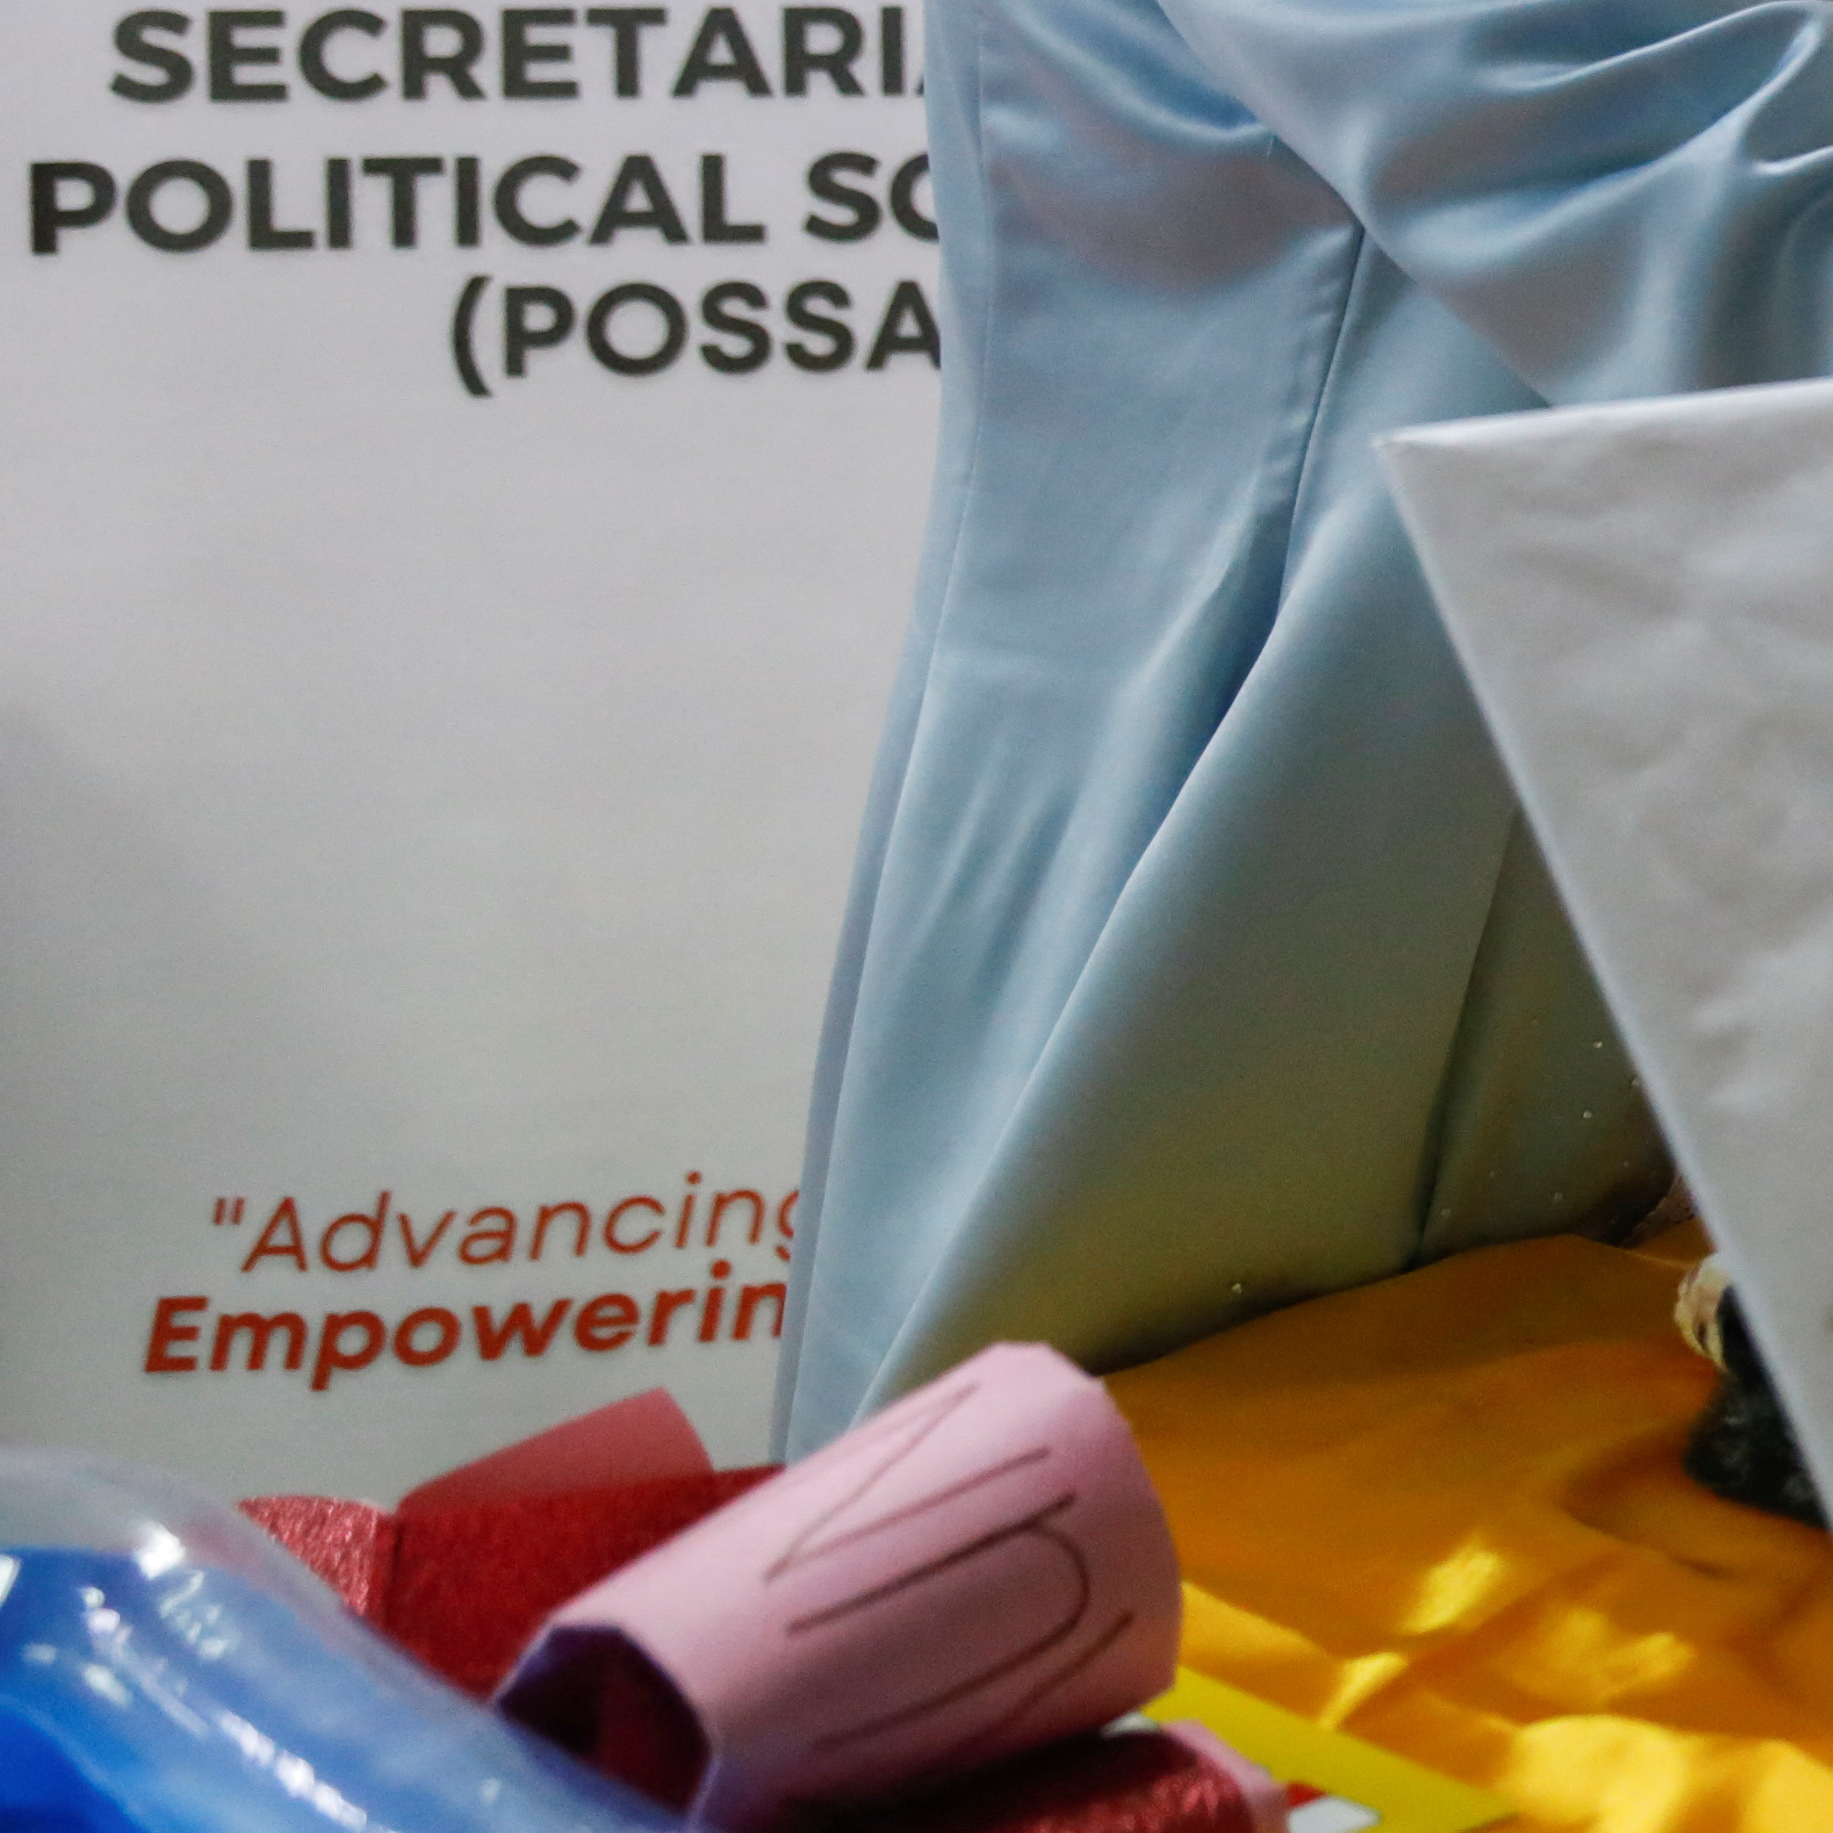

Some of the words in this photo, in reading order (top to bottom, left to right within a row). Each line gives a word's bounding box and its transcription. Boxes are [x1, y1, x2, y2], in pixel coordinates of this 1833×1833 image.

[110, 4, 924, 103] SECRETARI
[29, 152, 766, 255] POLITICAL
[452, 274, 942, 397] (POSSA
